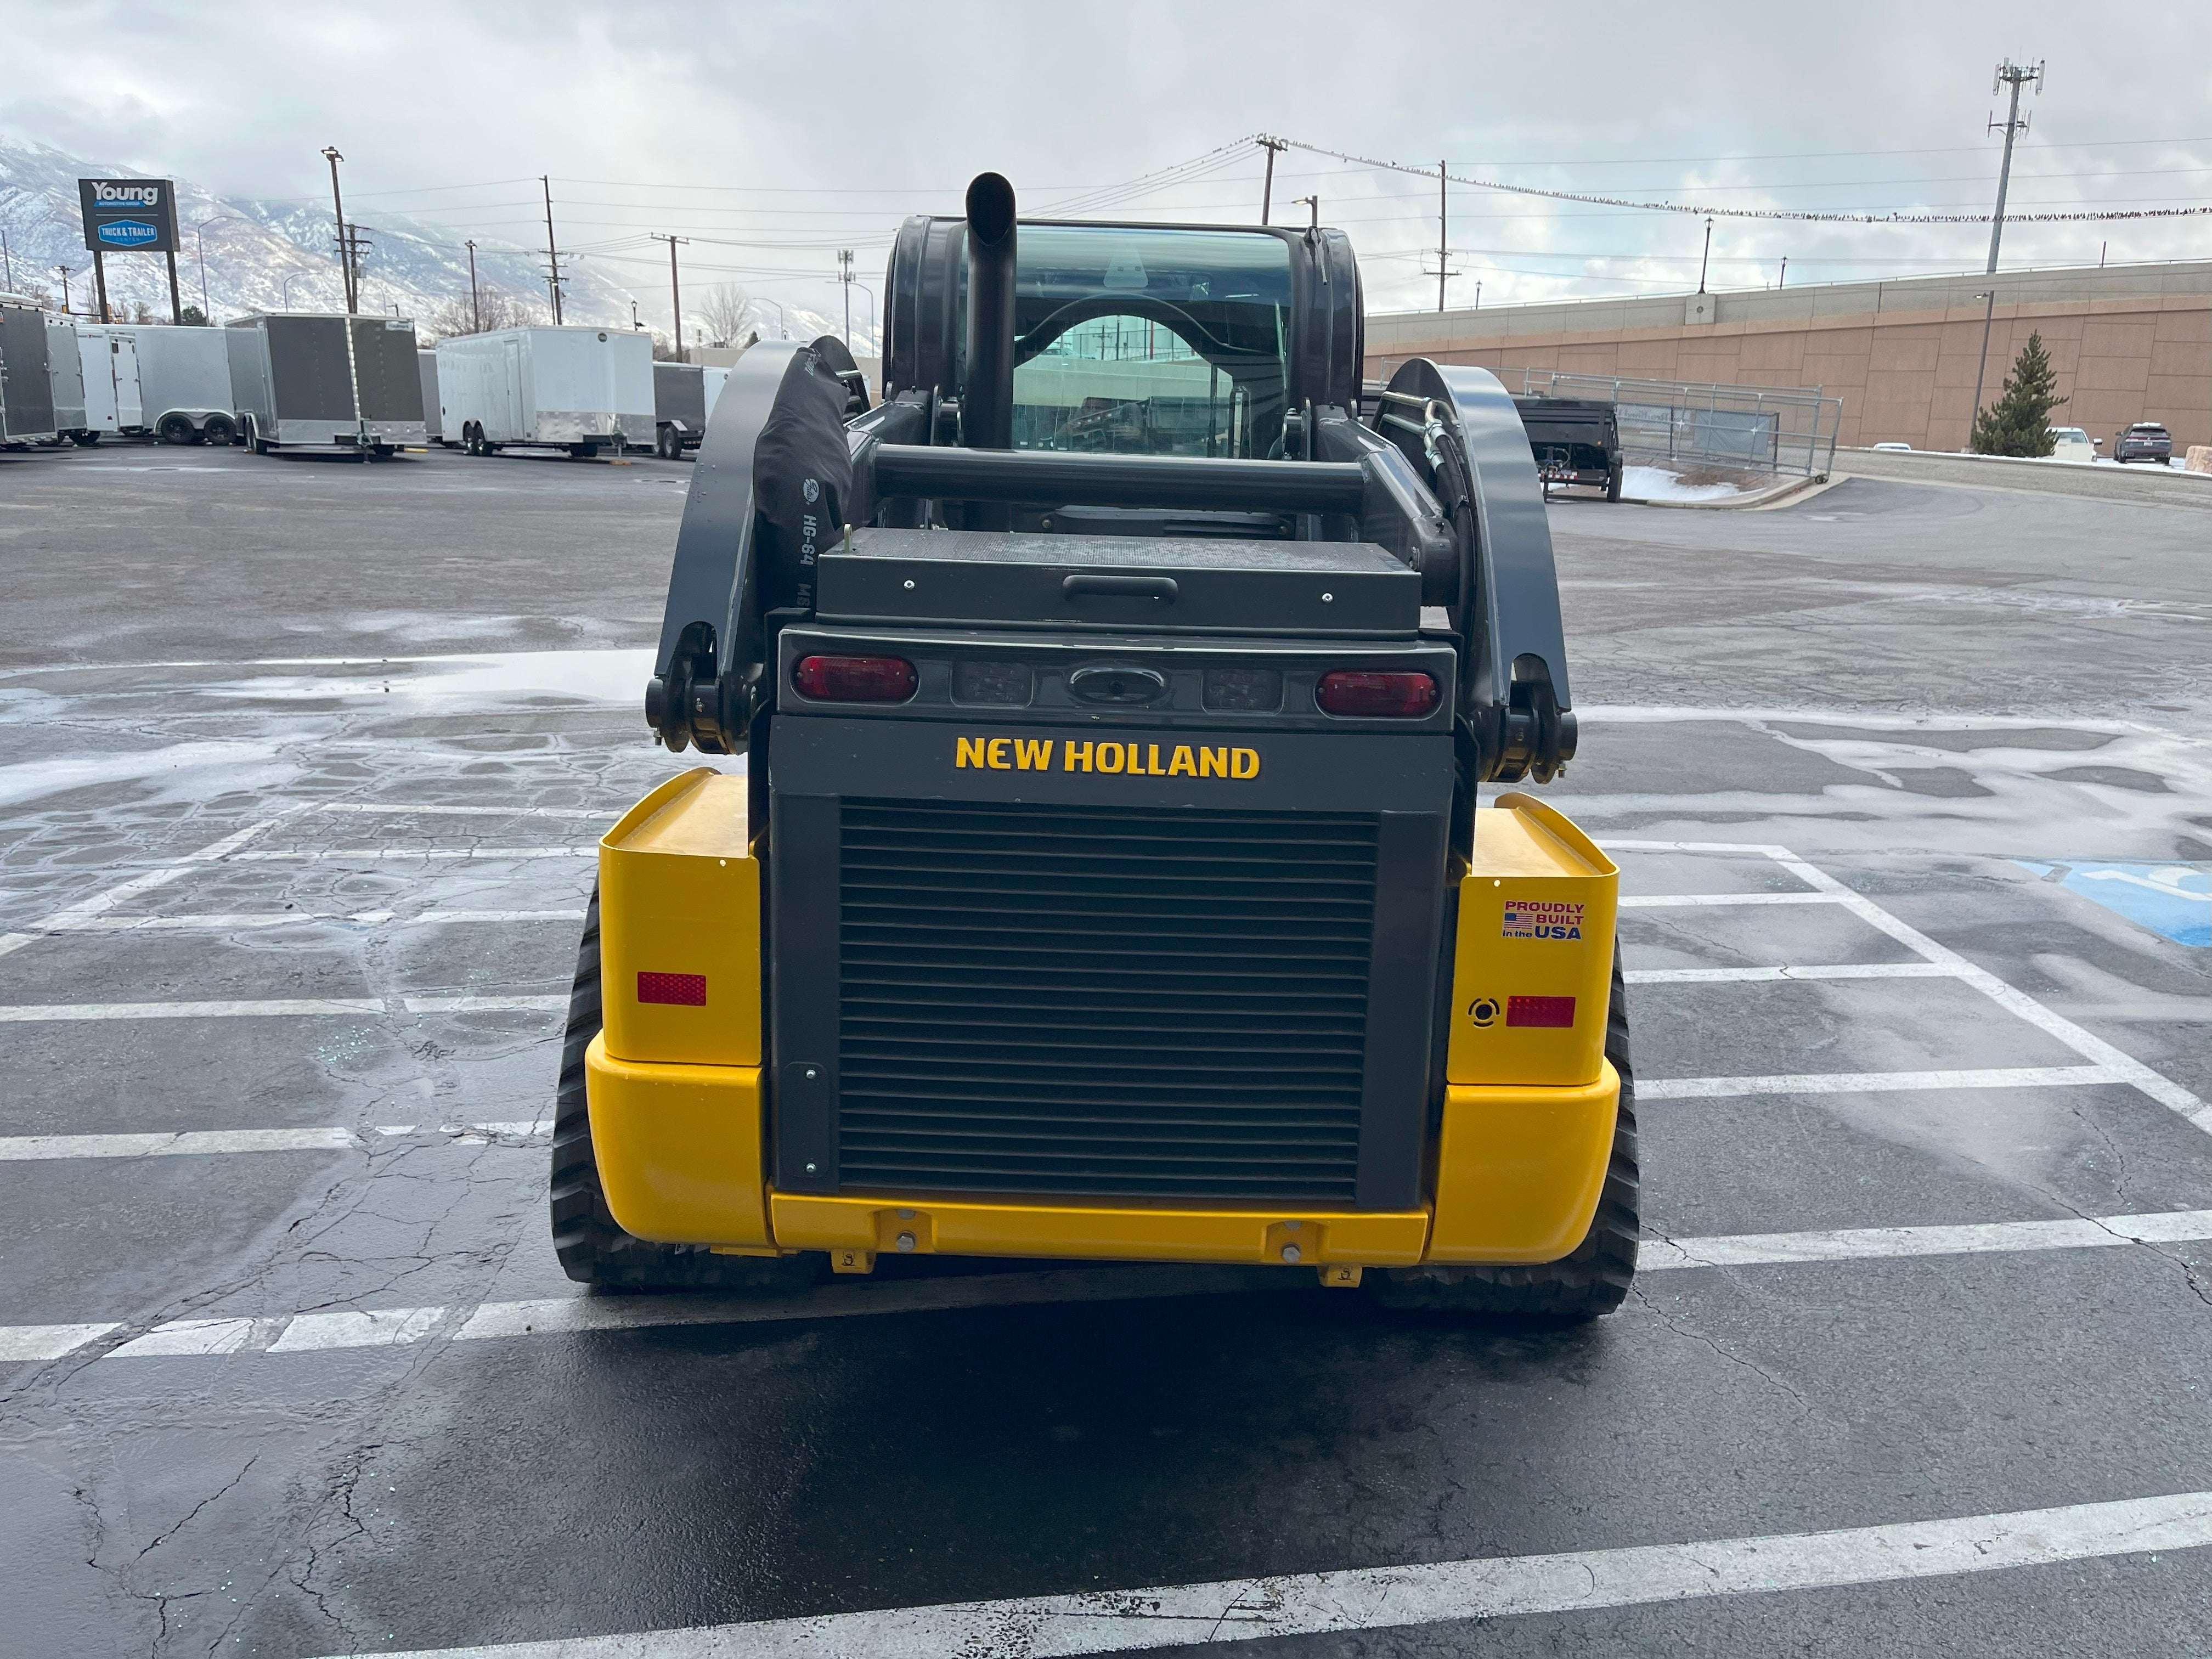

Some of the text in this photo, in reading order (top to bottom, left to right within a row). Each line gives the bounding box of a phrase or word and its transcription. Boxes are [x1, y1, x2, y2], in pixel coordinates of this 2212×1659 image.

[91, 182, 158, 206] Young
[101, 227, 154, 236] TRUCK & TRAILER
[800, 514, 817, 566] HG-64
[956, 737, 1260, 779] NEW HOLLAND
[1505, 901, 1584, 913] PROUDLY
[1536, 914, 1584, 925] BUILT
[1534, 926, 1582, 940] USA
